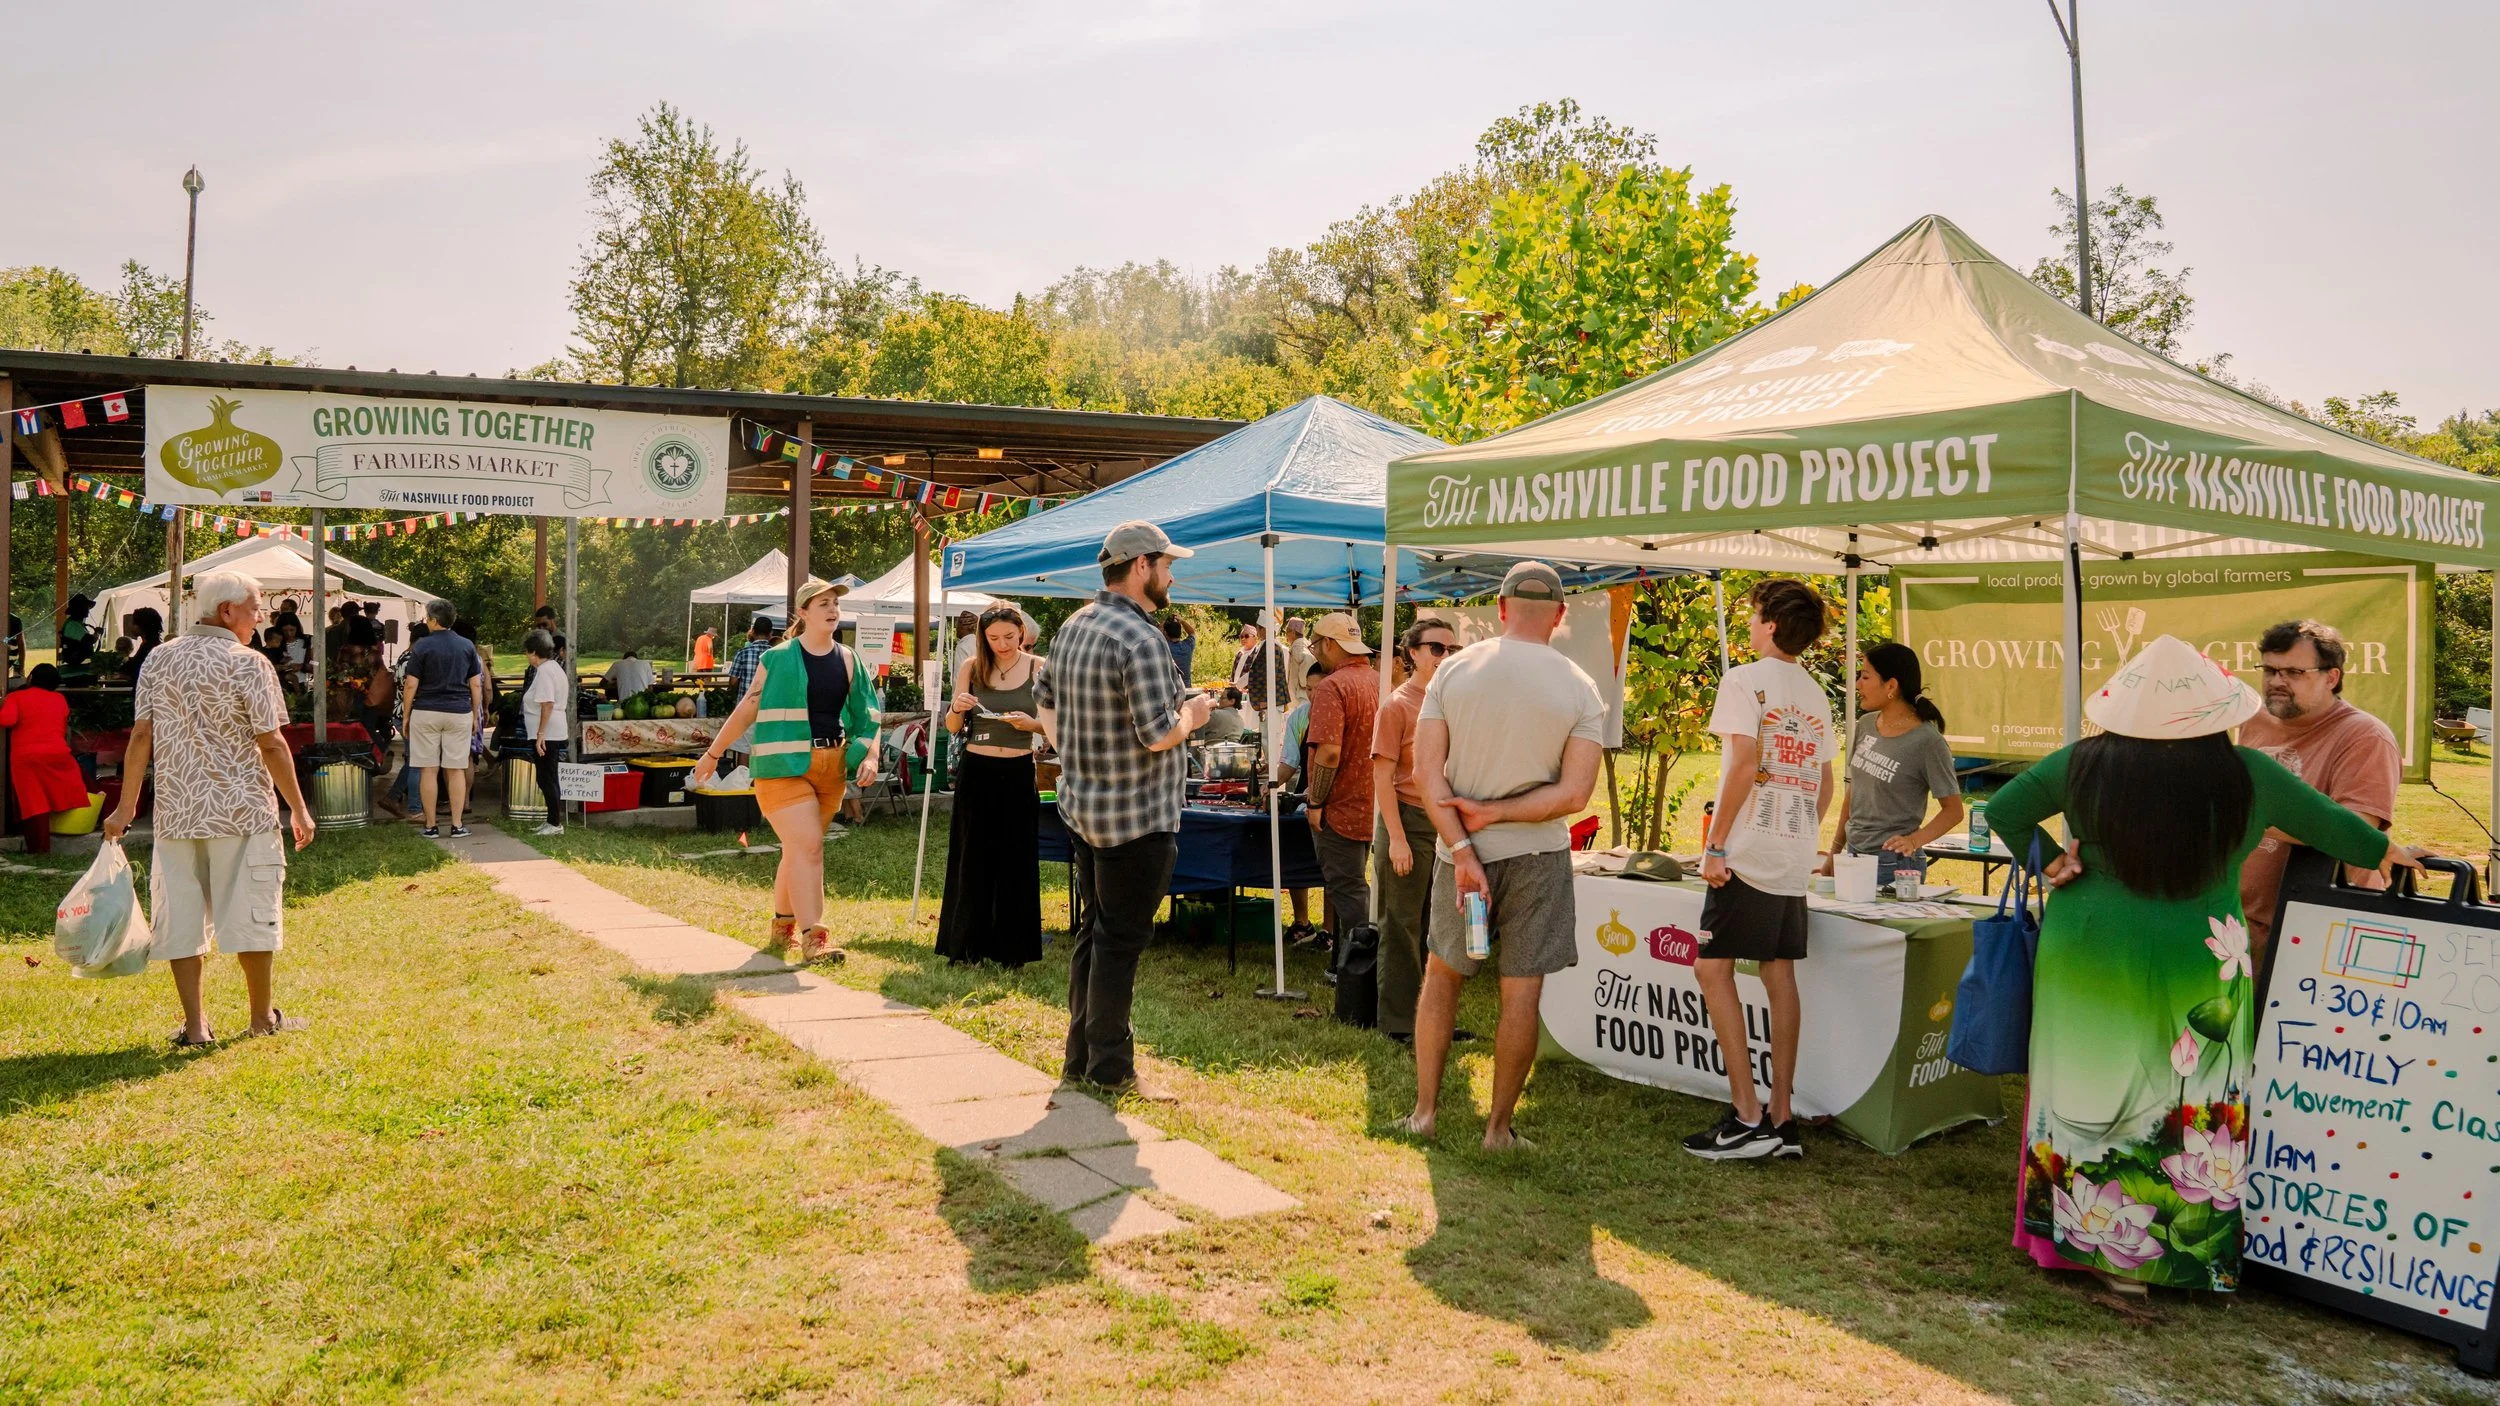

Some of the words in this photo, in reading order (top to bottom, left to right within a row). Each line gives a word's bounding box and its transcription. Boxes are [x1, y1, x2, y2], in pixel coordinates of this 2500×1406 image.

[1695, 365, 1896, 405] NASHVILLE
[313, 406, 449, 437] GROWING
[458, 408, 595, 450] TOGETHER
[1586, 410, 1689, 436] FOOD
[1685, 389, 1864, 425] PROJECT
[178, 432, 250, 469] GROWING
[195, 446, 263, 474] TOGETHER
[353, 453, 460, 471] FARMERS
[466, 454, 559, 478] MARKET
[1486, 461, 1669, 524] NASHVILLE
[1682, 452, 1788, 512] FOOD
[1800, 433, 1998, 505] PROJECT
[402, 492, 458, 505] NASHVILLE
[462, 494, 489, 506] FOOD
[491, 495, 535, 507] PROJECT
[2185, 451, 2330, 527] NASHVILLE
[2334, 476, 2397, 537] FOOD
[2400, 488, 2485, 549] PROJECT
[1987, 573, 2020, 588] local
[2025, 573, 2085, 590] produe
[2088, 574, 2138, 590] grown
[2142, 570, 2162, 588] by
[2166, 569, 2219, 588] global
[2223, 568, 2292, 583] farmers
[2154, 673, 2207, 694] NAM
[1991, 724, 2000, 733] a
[2003, 724, 2056, 738] program
[2007, 738, 2031, 748] Learn
[2032, 741, 2055, 749] more
[560, 767, 580, 775] REDIT
[70, 904, 90, 917] YOU
[2299, 977, 2369, 1017] 9:30
[1596, 1014, 1665, 1060] FOOD
[1908, 1056, 1950, 1088] FOOD
[2265, 1078, 2412, 1122] Movement
[2245, 1171, 2389, 1232] STORIES
[2413, 1211, 2470, 1248] OF
[2243, 1224, 2288, 1266] ood
